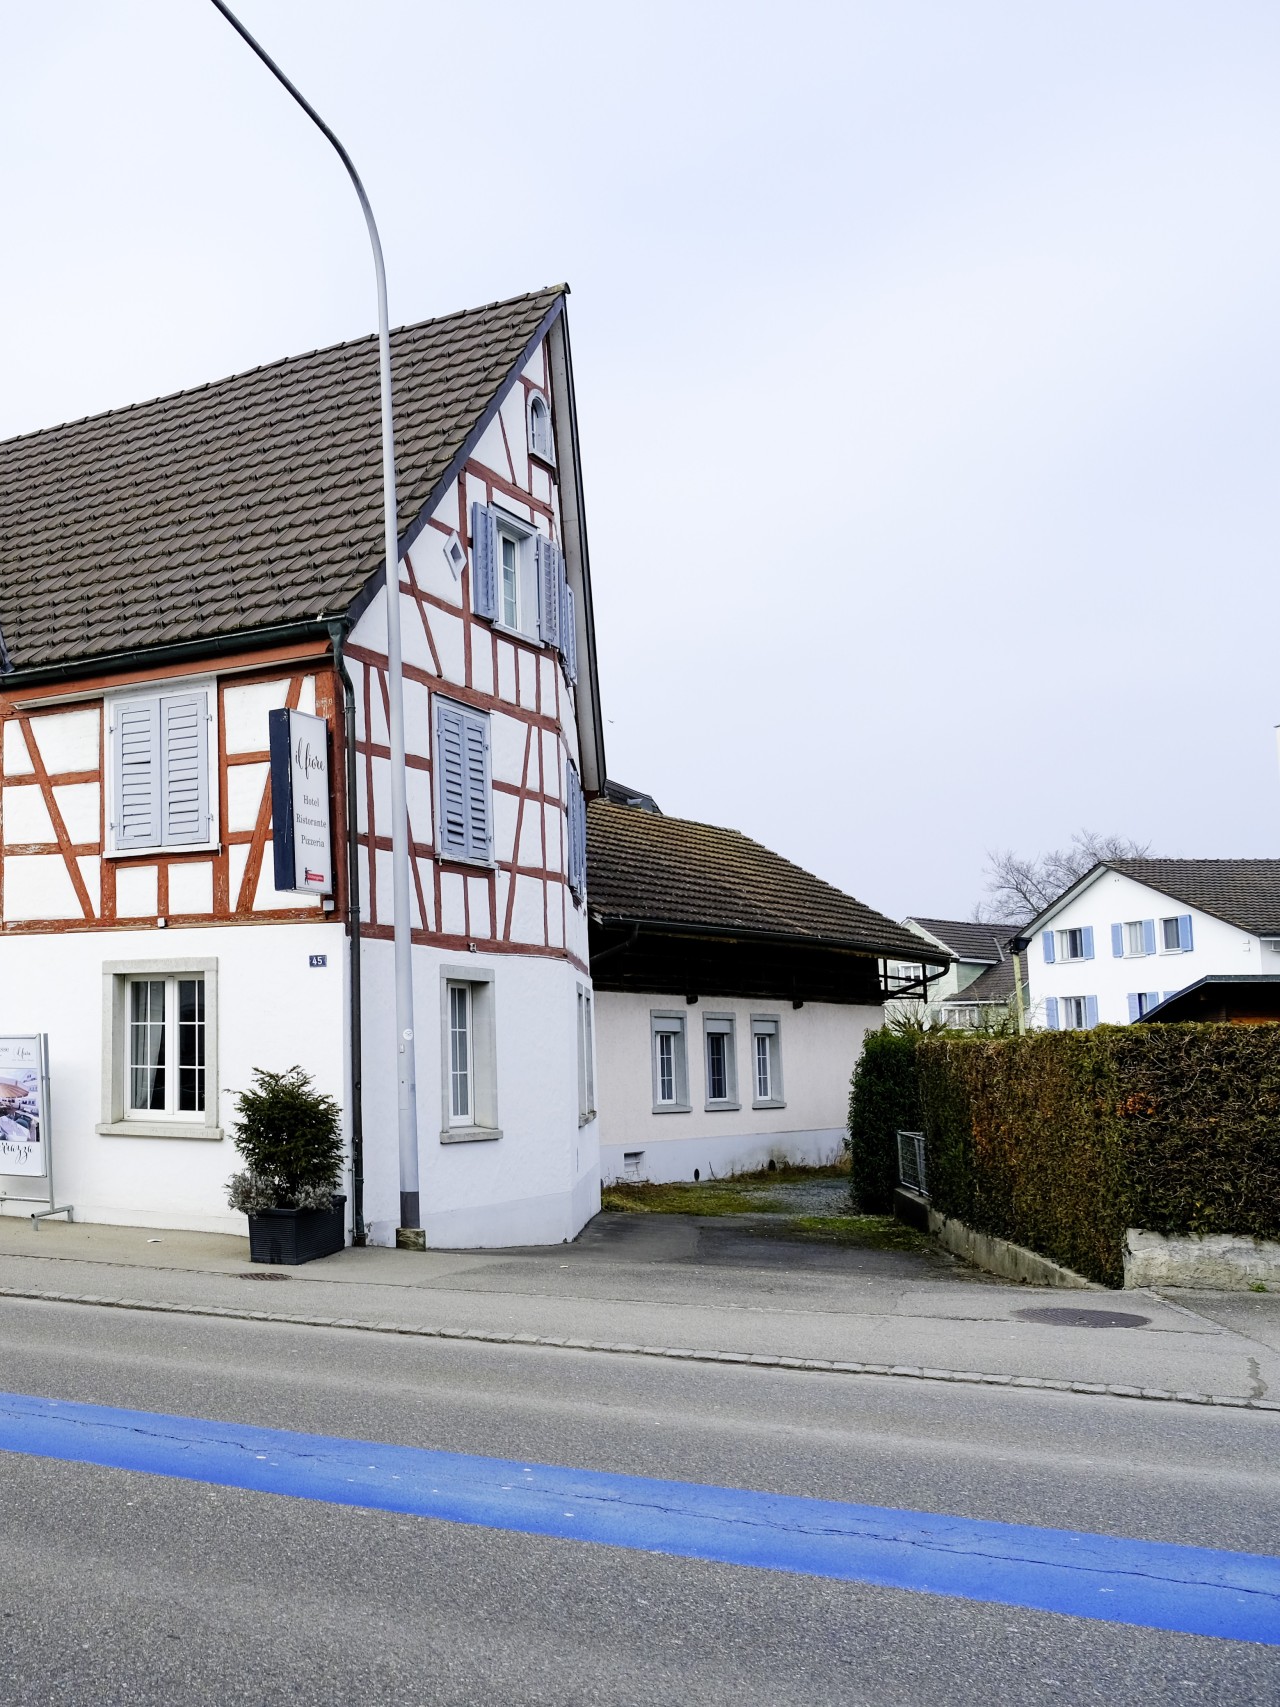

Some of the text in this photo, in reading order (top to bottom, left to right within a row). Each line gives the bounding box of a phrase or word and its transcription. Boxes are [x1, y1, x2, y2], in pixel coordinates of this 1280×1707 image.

[305, 743, 326, 780] fiore
[303, 795, 320, 807] Hotel
[296, 813, 327, 829] Ristorante
[301, 834, 325, 847] Pizzeria
[312, 956, 323, 965] 45
